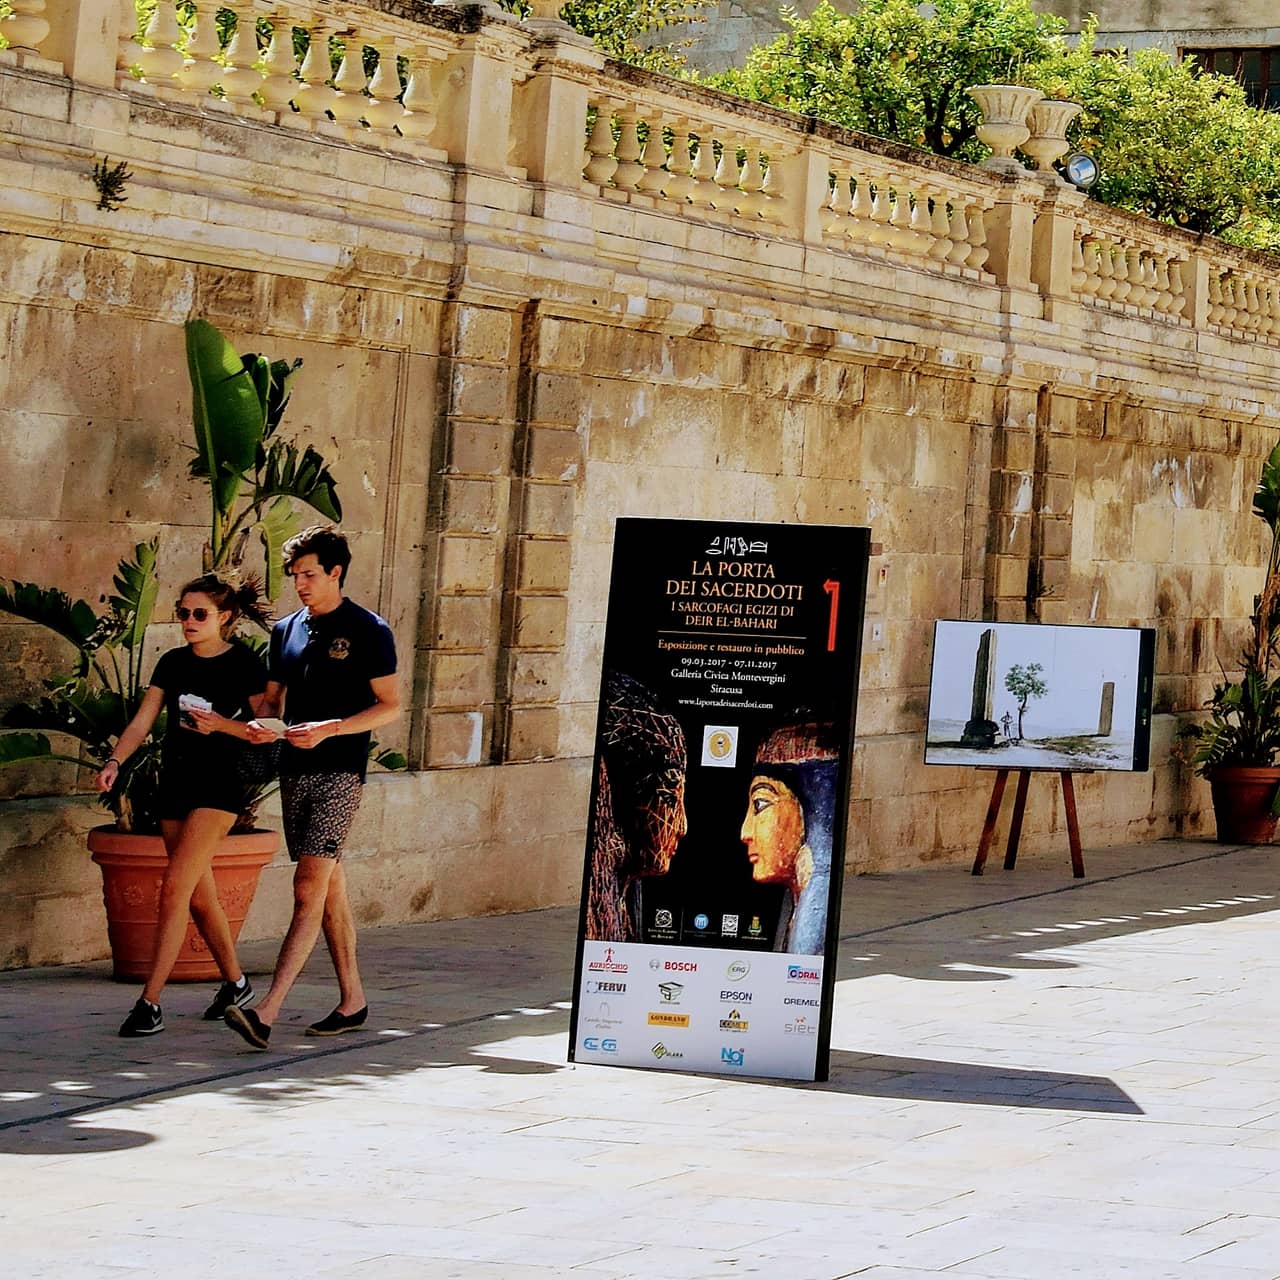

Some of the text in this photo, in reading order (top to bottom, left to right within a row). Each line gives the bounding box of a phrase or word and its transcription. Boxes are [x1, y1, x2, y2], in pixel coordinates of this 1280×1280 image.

[692, 560, 776, 578] LA PORTA
[666, 579, 804, 600] DEI SACERDOTI
[678, 601, 743, 615] SARCOFAGI
[745, 604, 777, 616] EGIZI
[780, 605, 795, 617] DI
[685, 615, 778, 629] DEIR EL-BAHARI
[658, 638, 708, 652] Esposizione
[717, 642, 752, 653] restauro
[754, 643, 763, 654] in
[765, 643, 805, 656] pubblico
[670, 668, 786, 685] Galleria Civica Montevergini
[710, 683, 743, 695] Siracusa
[663, 961, 698, 972] BOSCH
[598, 981, 627, 992] FERVI
[720, 990, 753, 1001] EPSON
[783, 997, 820, 1007] DREMEL
